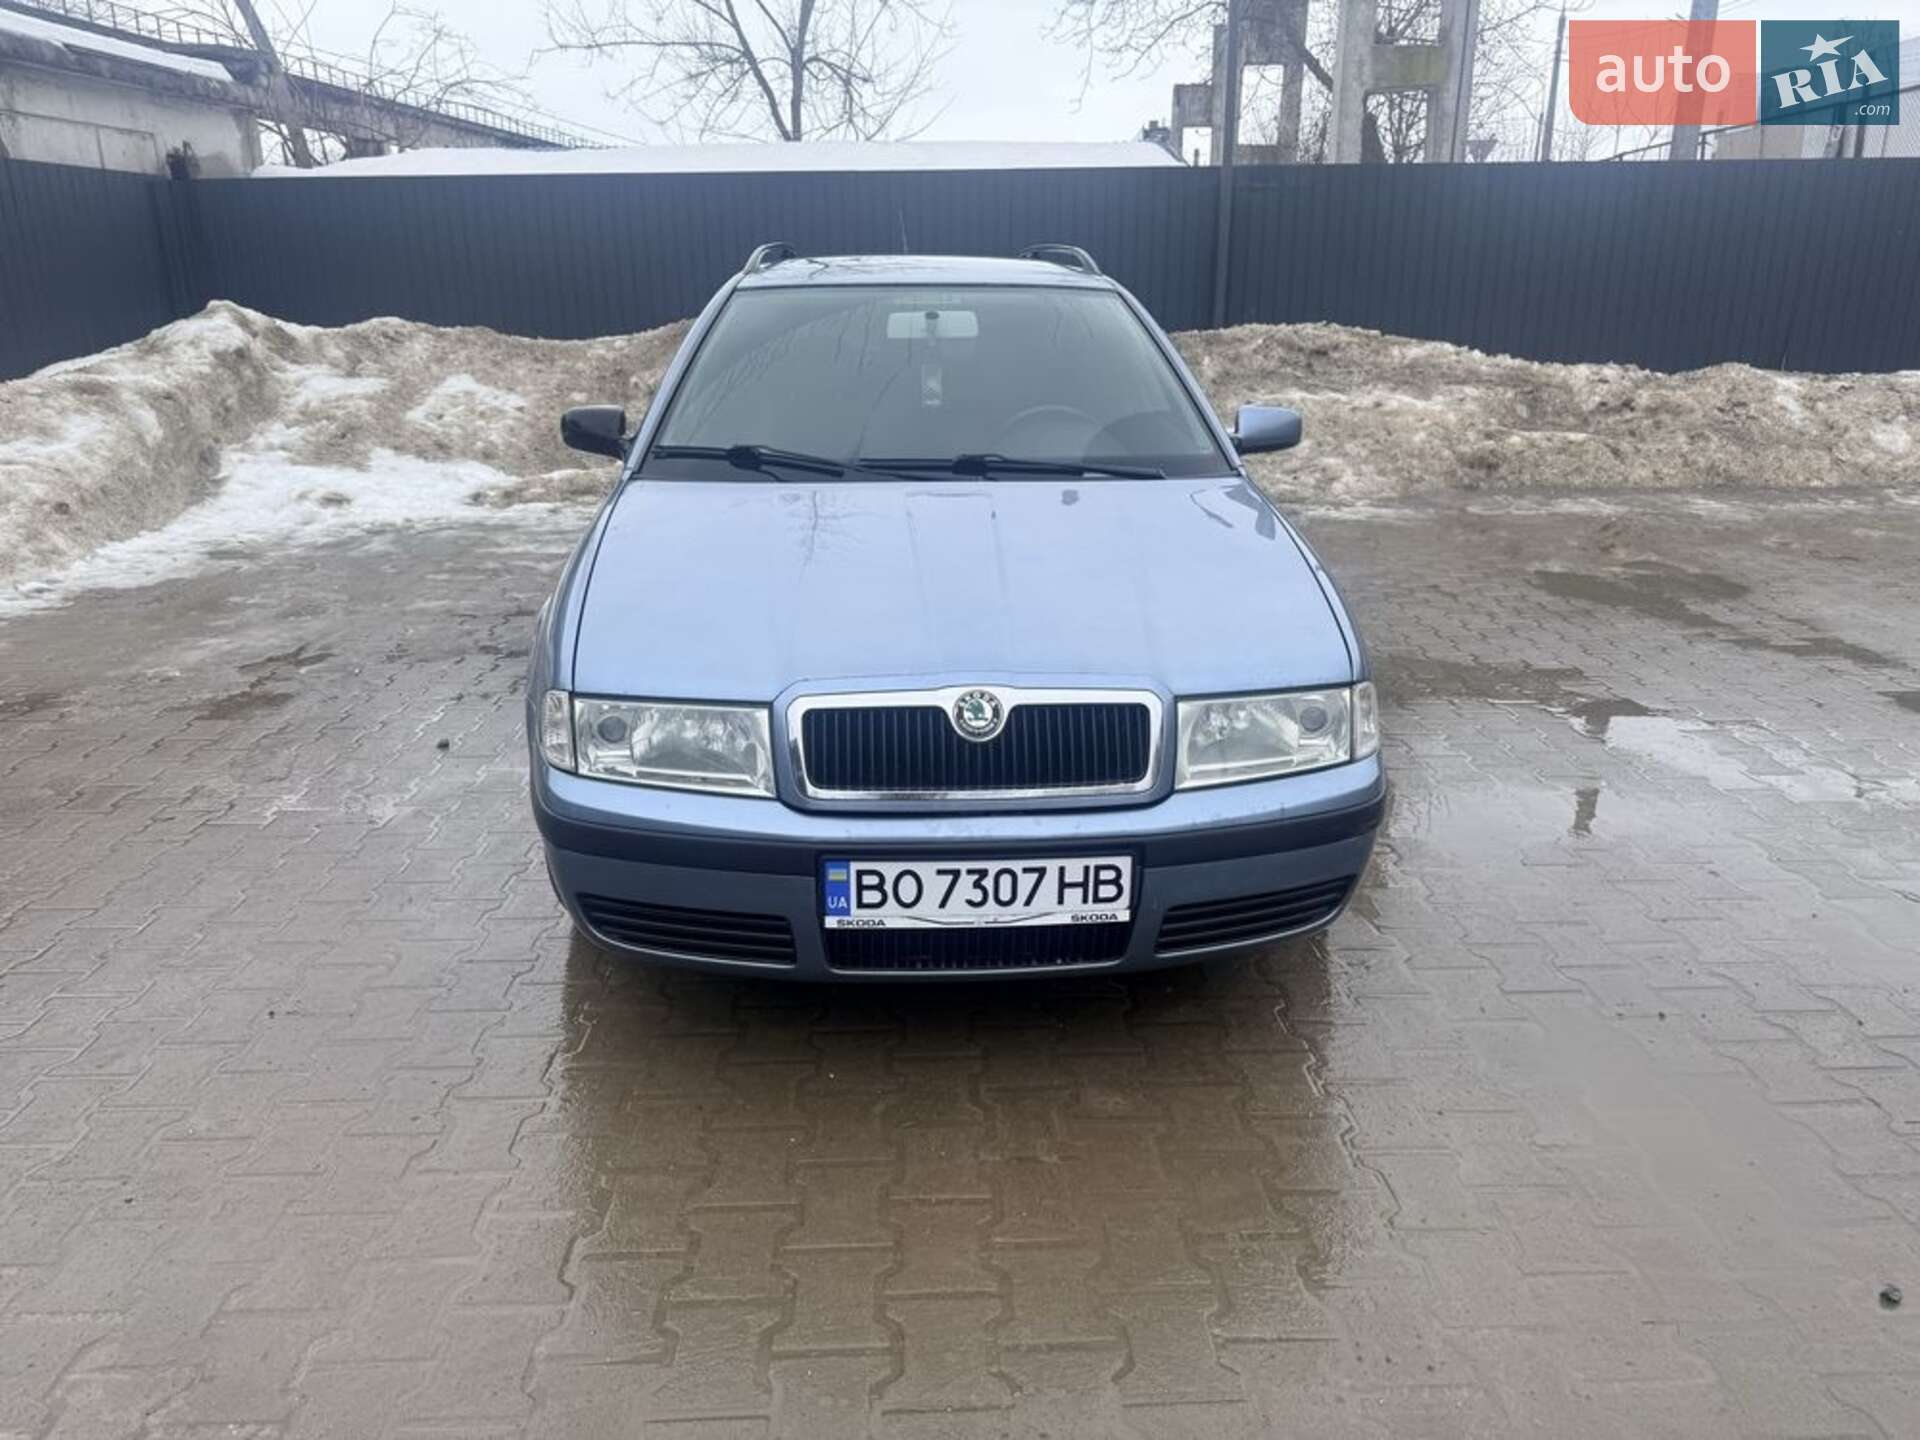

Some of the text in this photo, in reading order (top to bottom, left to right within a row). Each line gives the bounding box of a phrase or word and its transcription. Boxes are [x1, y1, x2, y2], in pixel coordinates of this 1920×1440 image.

[855, 864, 1124, 909] BO 7307 HB
[828, 895, 848, 909] UA
